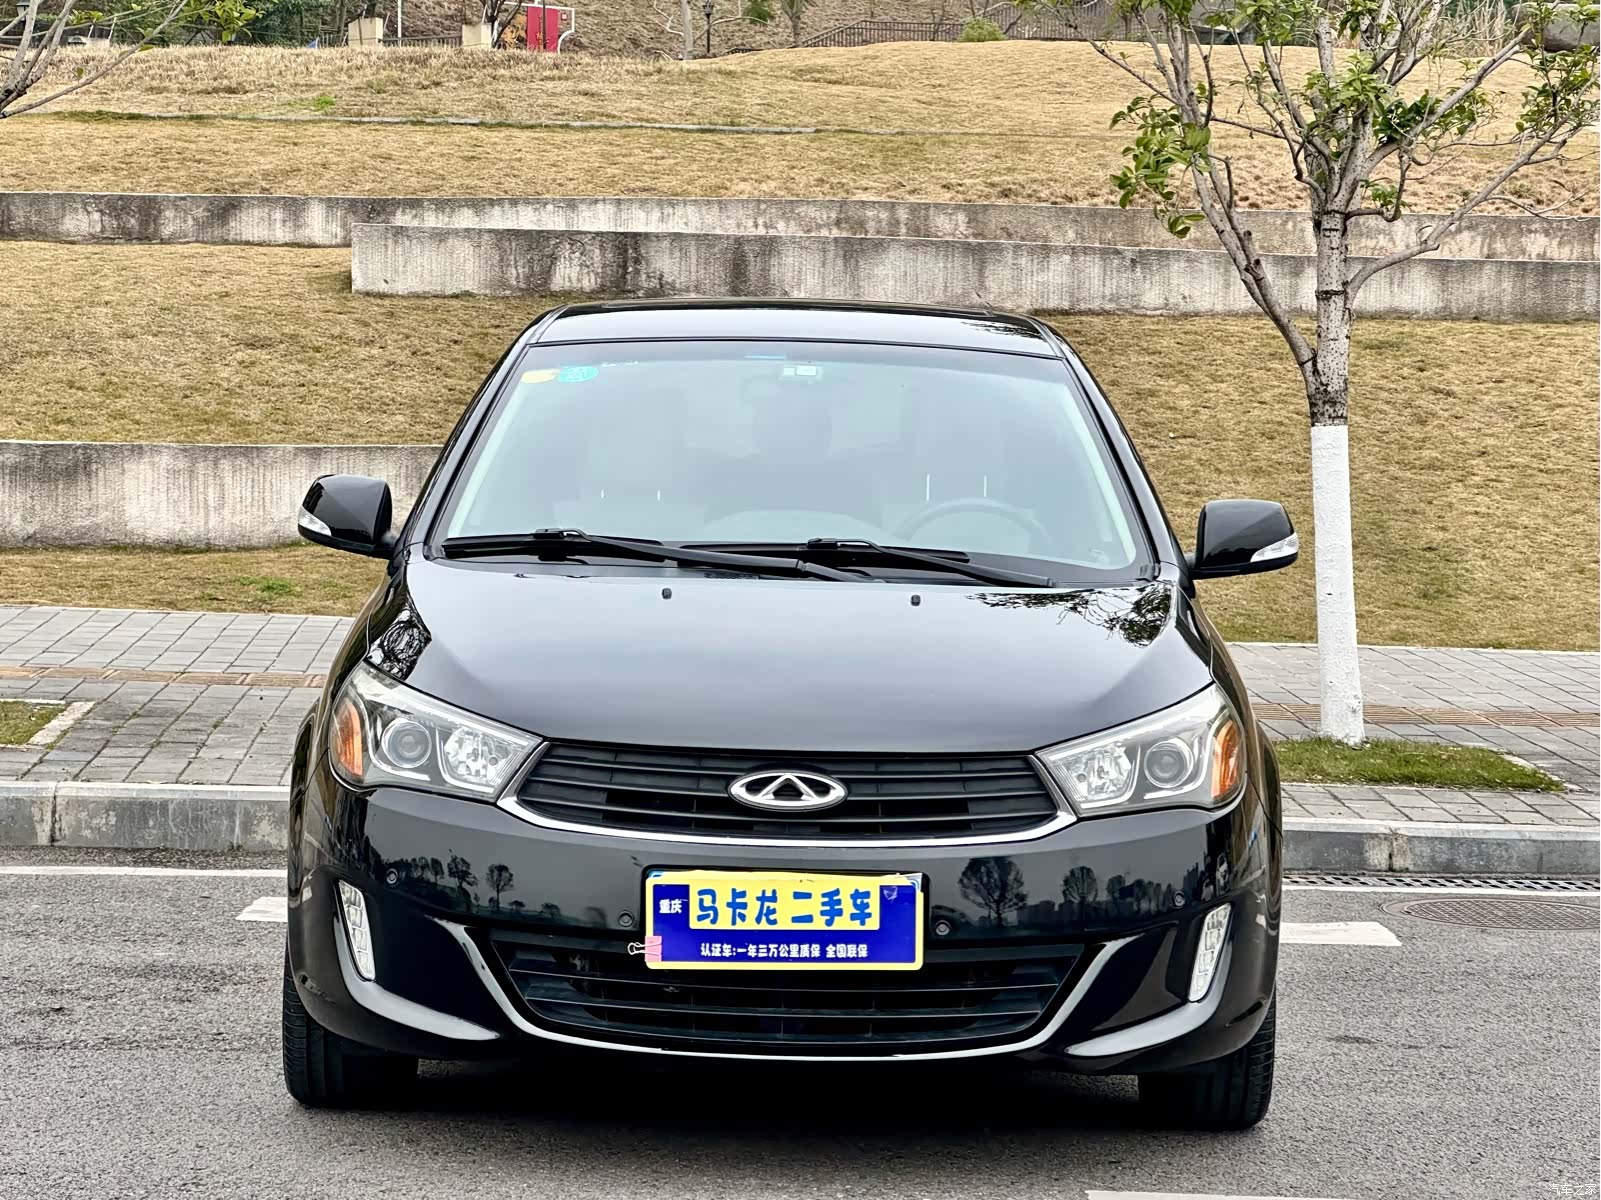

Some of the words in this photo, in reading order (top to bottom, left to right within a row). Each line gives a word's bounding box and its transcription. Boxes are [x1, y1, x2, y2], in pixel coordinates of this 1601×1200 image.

[659, 899, 682, 914] 重庆
[696, 888, 778, 926] 马卡龙
[791, 888, 873, 927] 二手车
[701, 943, 821, 958] 认证车:一年三万公里质保
[825, 943, 869, 959] 全国联保
